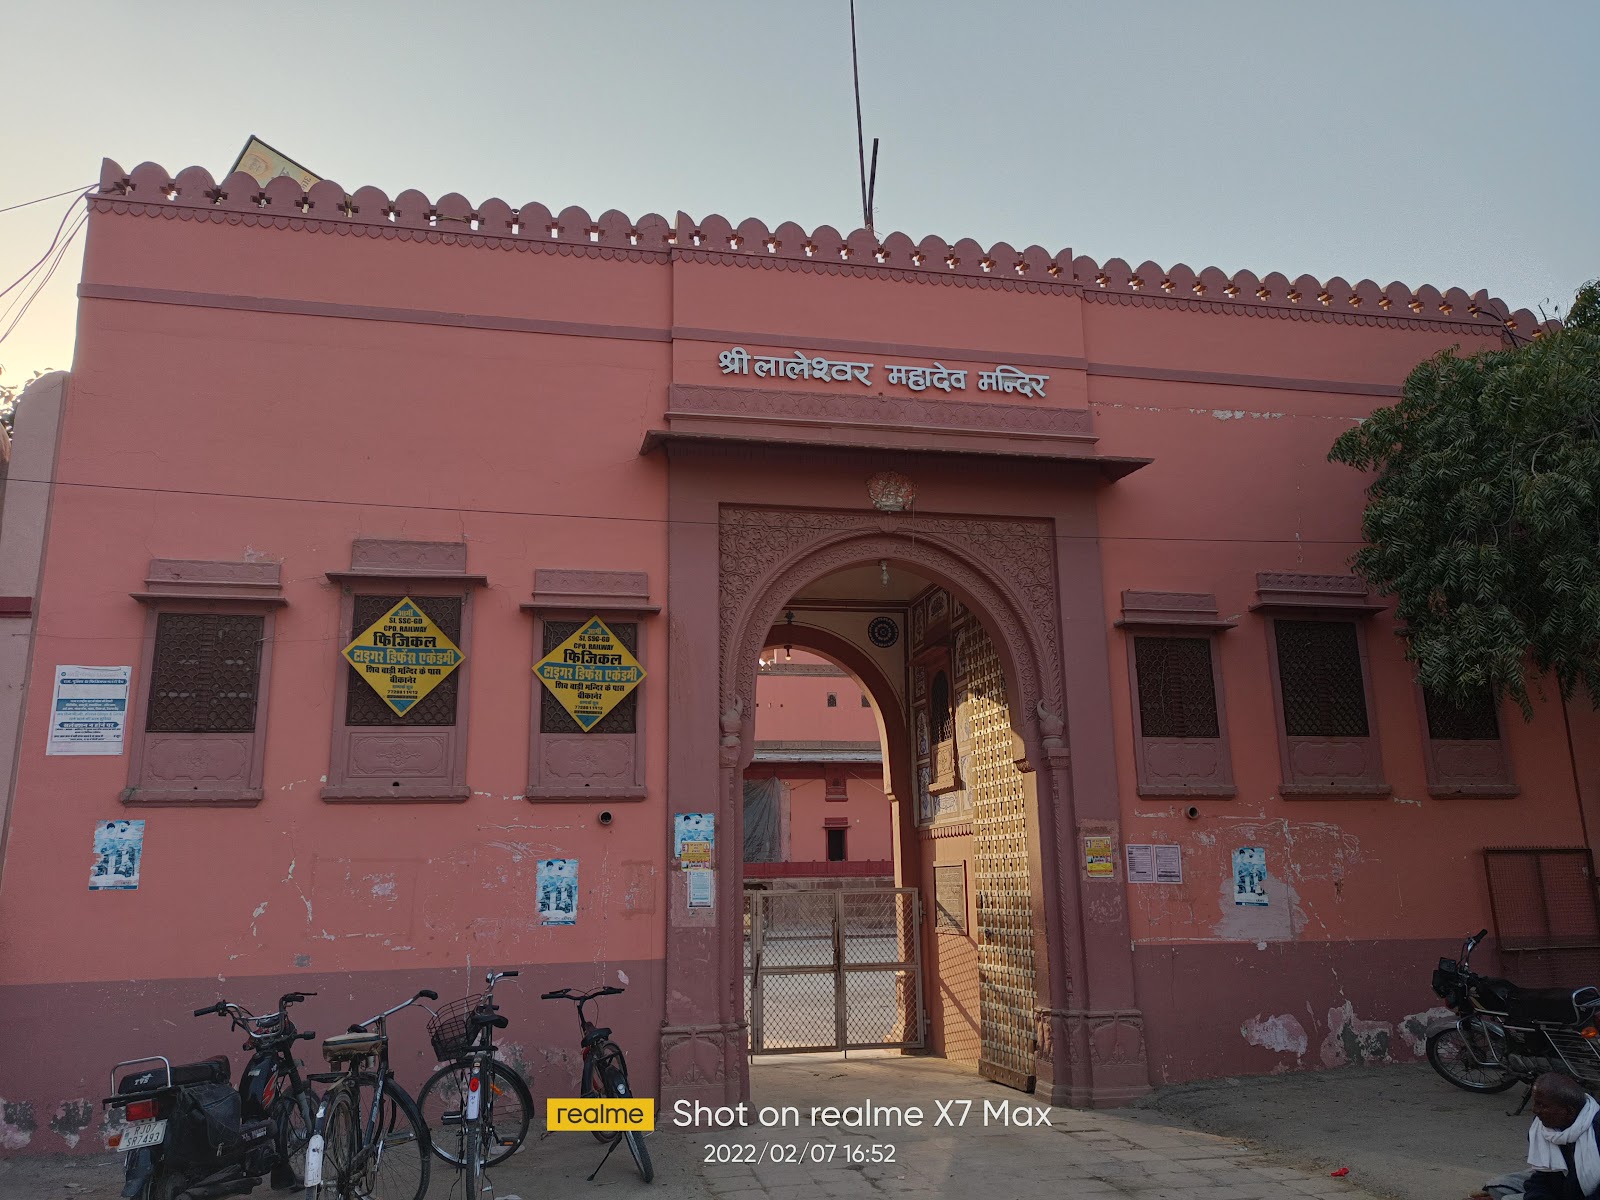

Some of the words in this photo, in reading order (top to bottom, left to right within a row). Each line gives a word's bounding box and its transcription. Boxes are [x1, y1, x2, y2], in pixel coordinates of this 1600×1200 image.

[718, 347, 751, 375] श्री
[754, 351, 874, 386] लालेश्वर
[885, 362, 968, 392] महादेव
[978, 364, 1050, 398] मन्दिर
[373, 632, 437, 648] फिजिकल
[354, 649, 384, 664] टाइगर
[419, 649, 455, 665] एकेडमी
[563, 649, 622, 665] फिजिकल
[390, 675, 416, 684] बीकानेर
[544, 665, 572, 680] टाइगर
[605, 666, 637, 681] एकेडमी
[578, 691, 602, 700] बीकानेर
[134, 1124, 157, 1136] RJ07
[126, 1132, 160, 1147] SR7493
